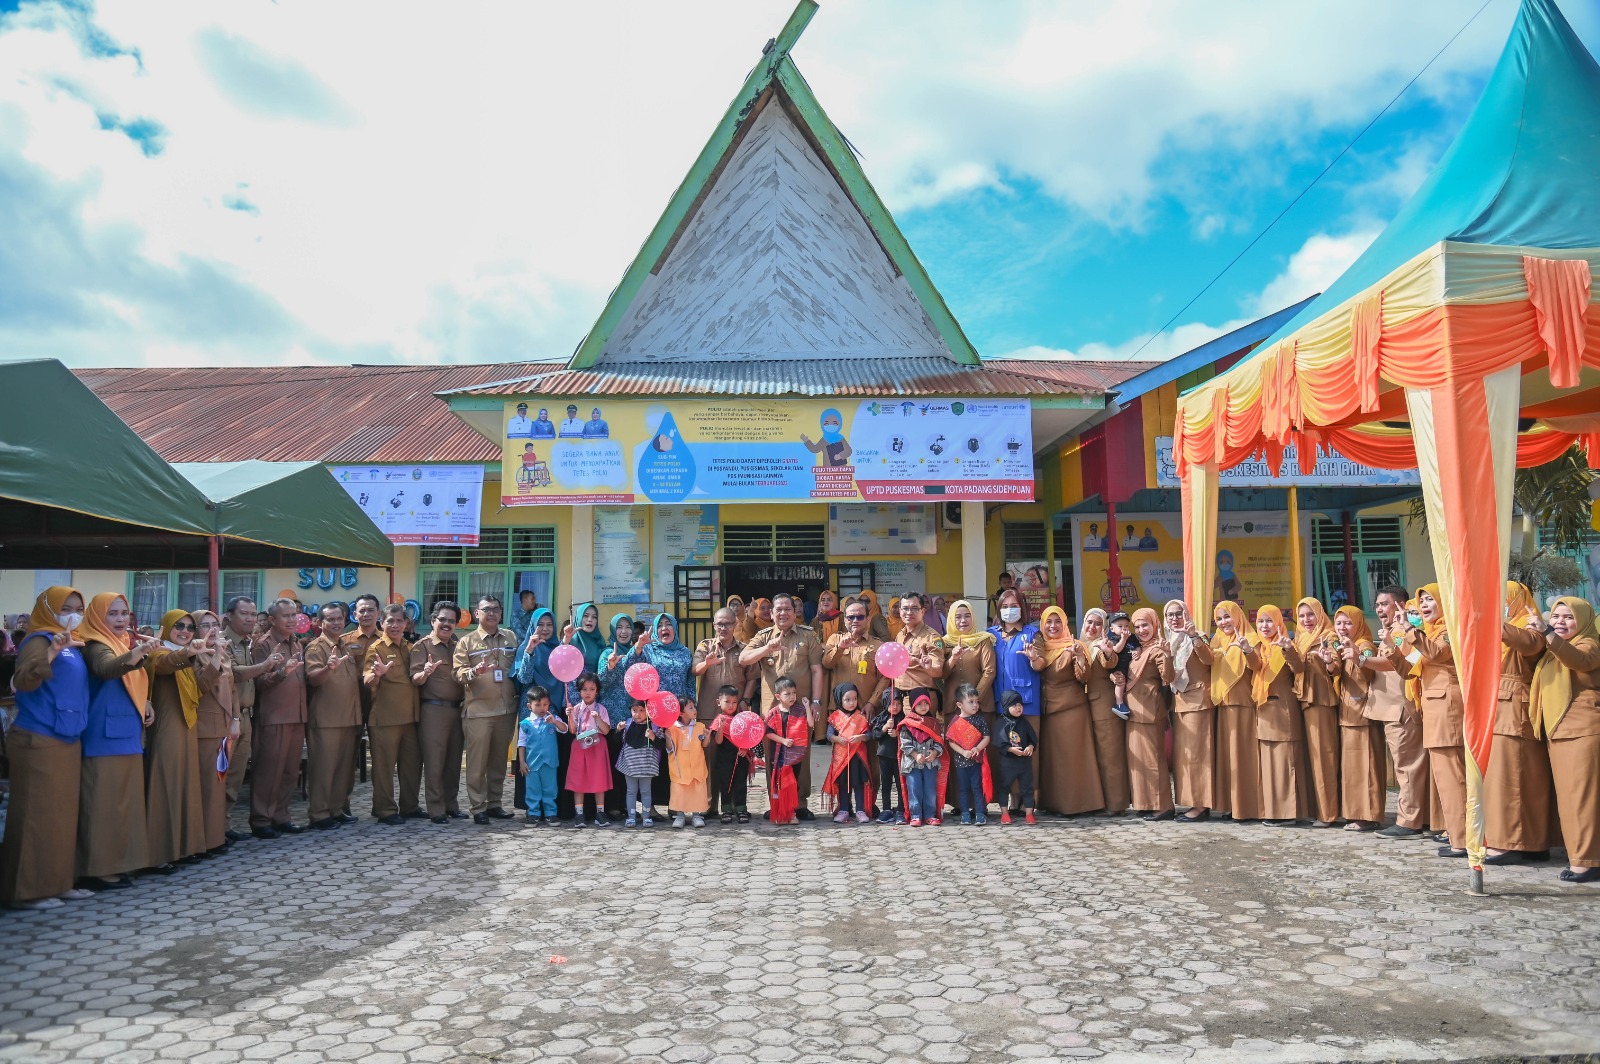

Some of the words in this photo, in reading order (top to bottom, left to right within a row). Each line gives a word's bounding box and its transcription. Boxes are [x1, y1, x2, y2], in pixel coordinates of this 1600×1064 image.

[562, 450, 583, 458] SEGERA
[573, 469, 590, 477] TETES
[866, 485, 884, 495] UPTD
[885, 485, 925, 495] PUSKESMAS
[945, 485, 963, 495] KOTA
[964, 485, 993, 495] PADANG
[992, 485, 1031, 495] SIDEMPUAN
[296, 567, 358, 590] SUB
